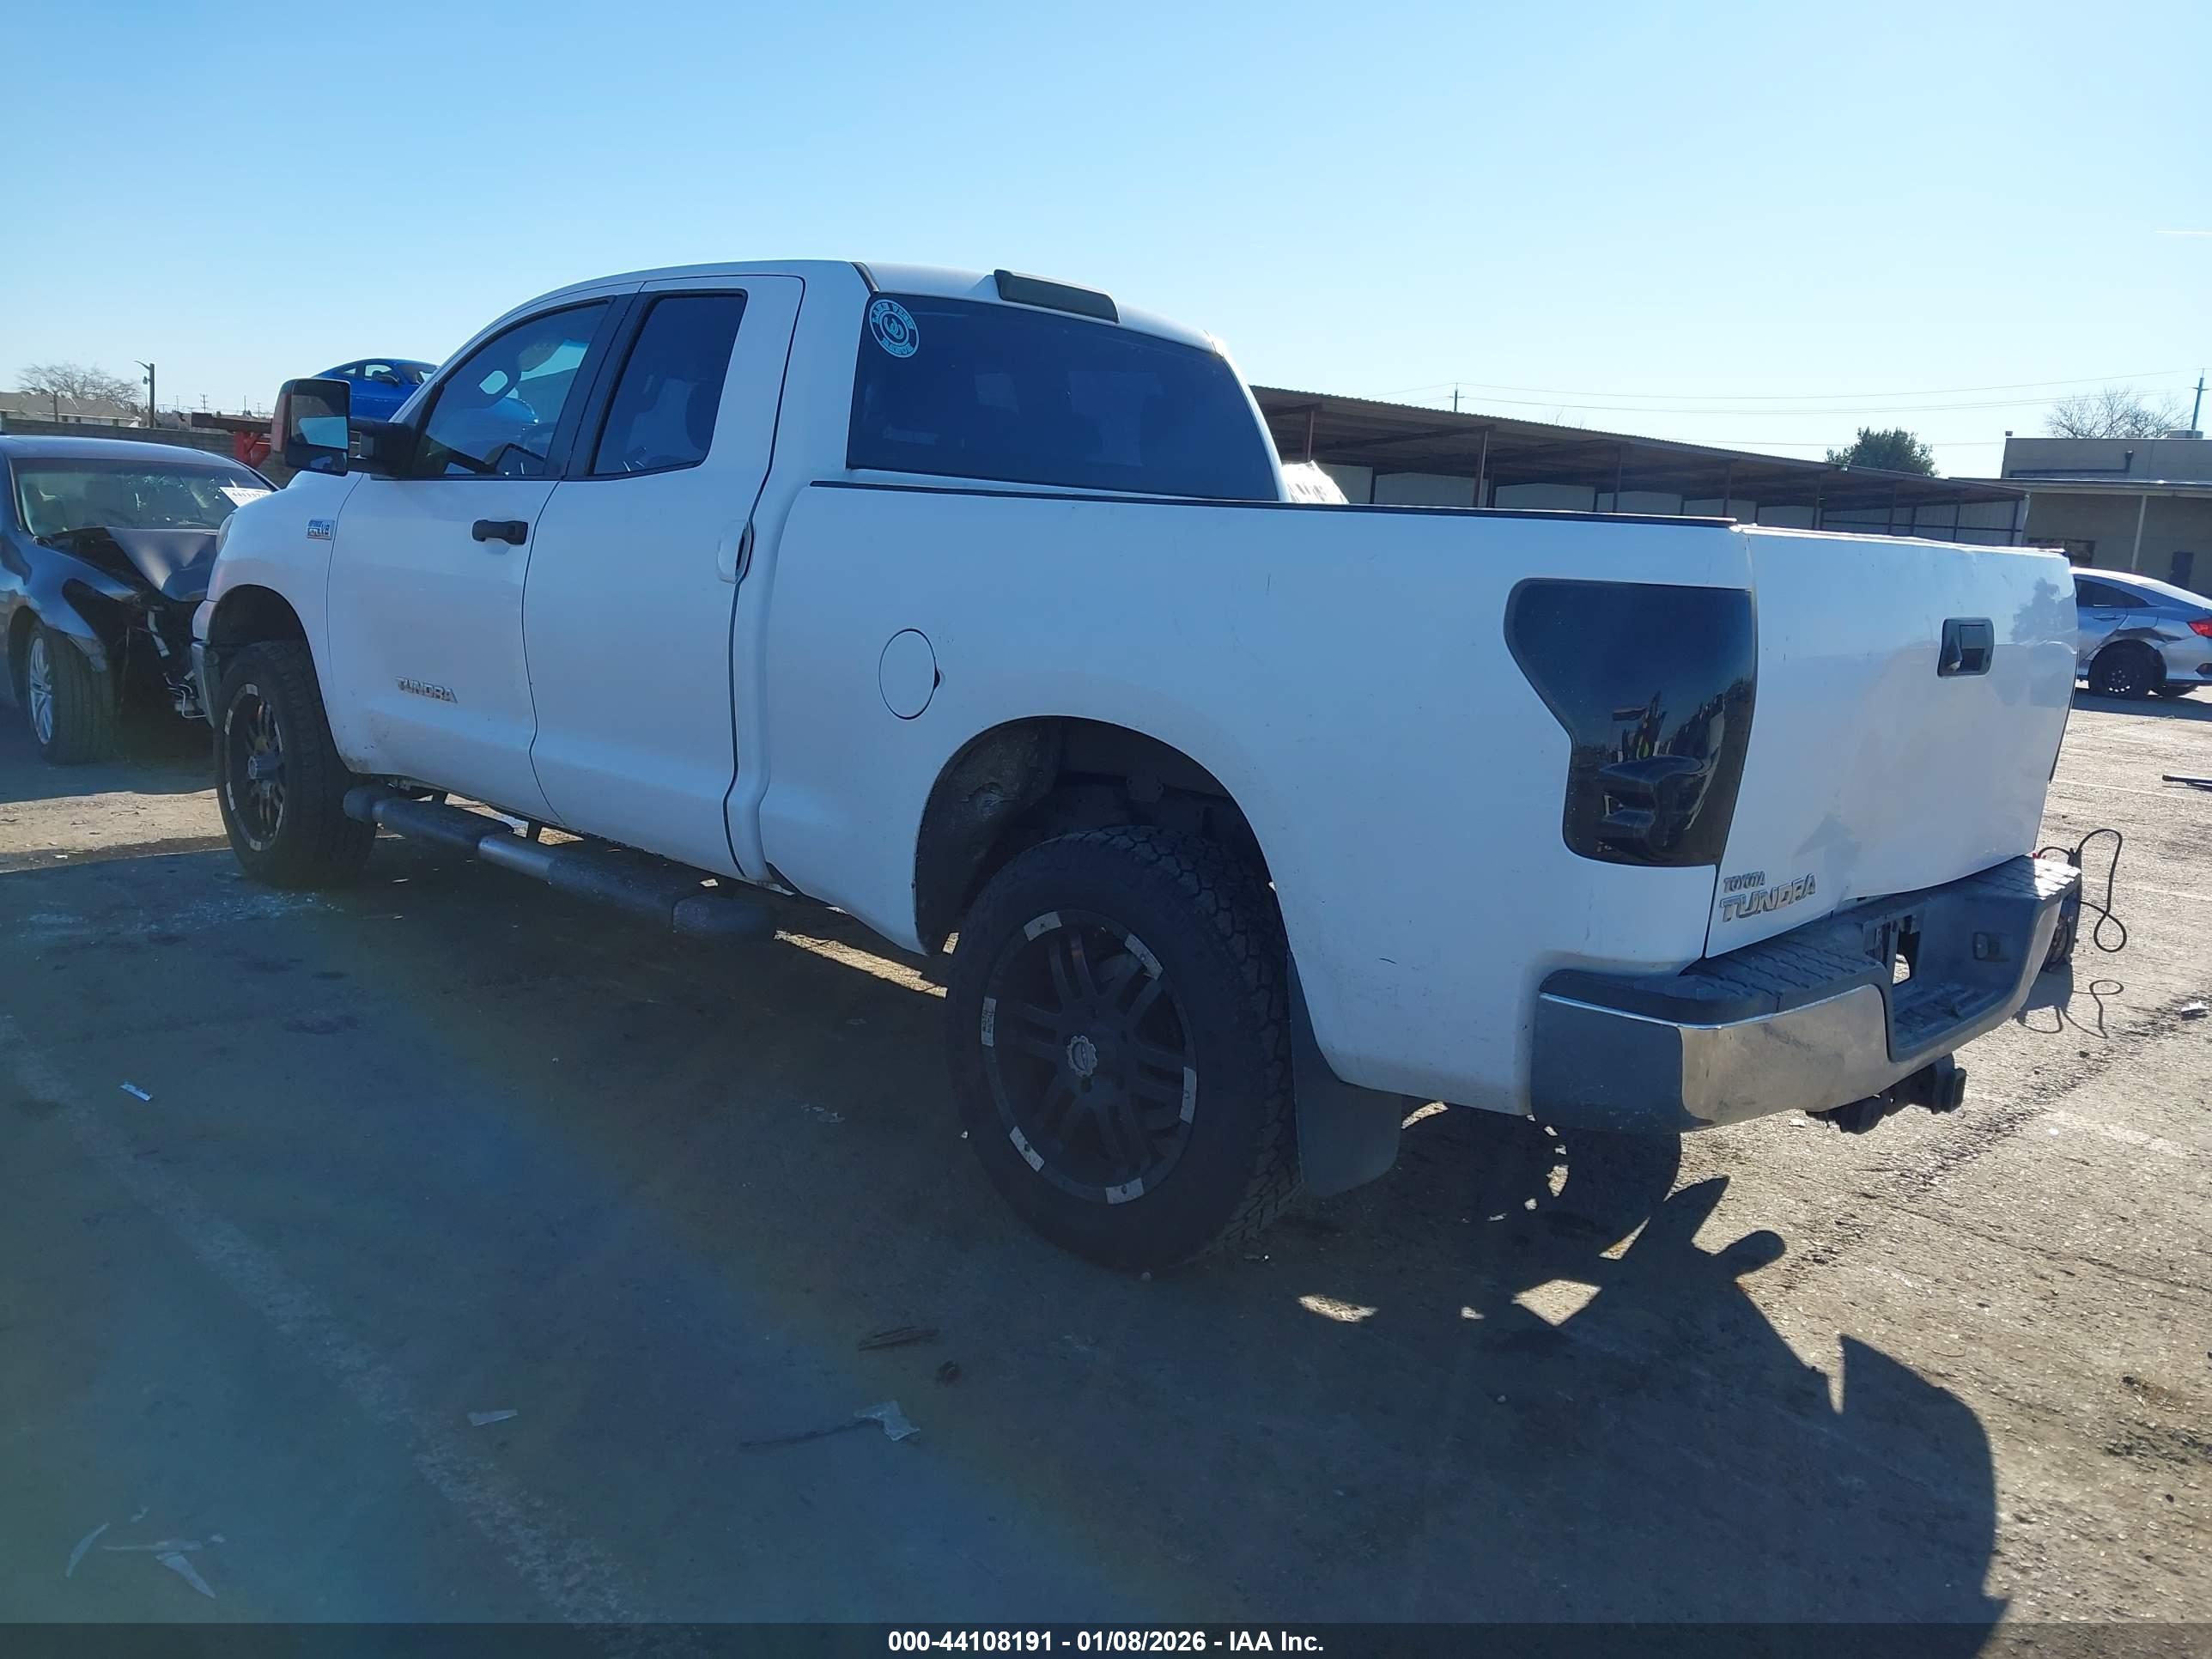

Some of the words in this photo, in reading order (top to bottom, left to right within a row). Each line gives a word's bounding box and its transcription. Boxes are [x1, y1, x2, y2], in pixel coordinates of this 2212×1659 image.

[395, 676, 458, 703] TUNDRA
[1723, 871, 1765, 894] TOYOTA
[1719, 872, 1816, 923] TUNDRA
